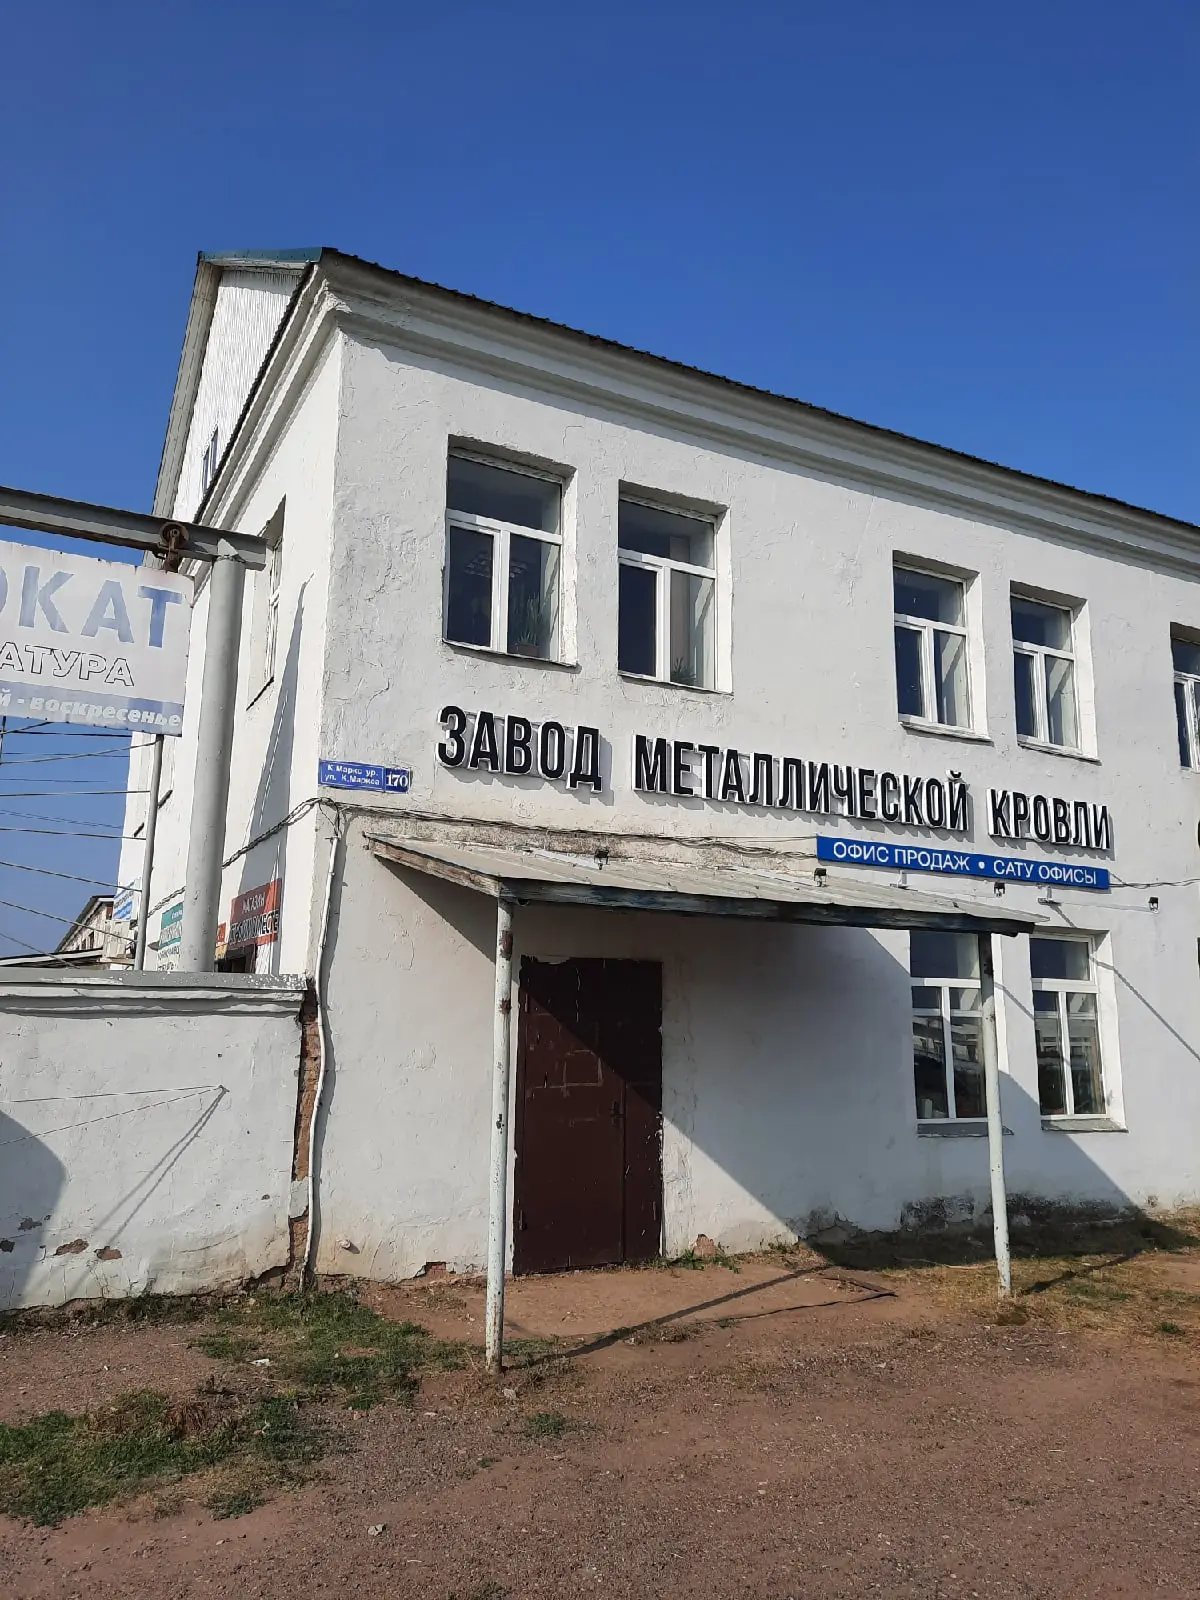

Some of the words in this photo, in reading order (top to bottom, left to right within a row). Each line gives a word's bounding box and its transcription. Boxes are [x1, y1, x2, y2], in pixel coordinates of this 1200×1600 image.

[0, 565, 182, 648] КАТ
[29, 696, 182, 727] воскресенье
[386, 774, 409, 788] 170
[435, 704, 603, 793] ЗАВОД
[632, 733, 969, 832] МЕТАЛЛИЧЕСКОЙ
[986, 787, 1111, 850] КРОВЛИ
[833, 841, 889, 863] ОФИС
[894, 848, 970, 871] ПРОДАЖ
[993, 860, 1034, 879] САТУ
[1038, 865, 1097, 885] ОФИСЫ
